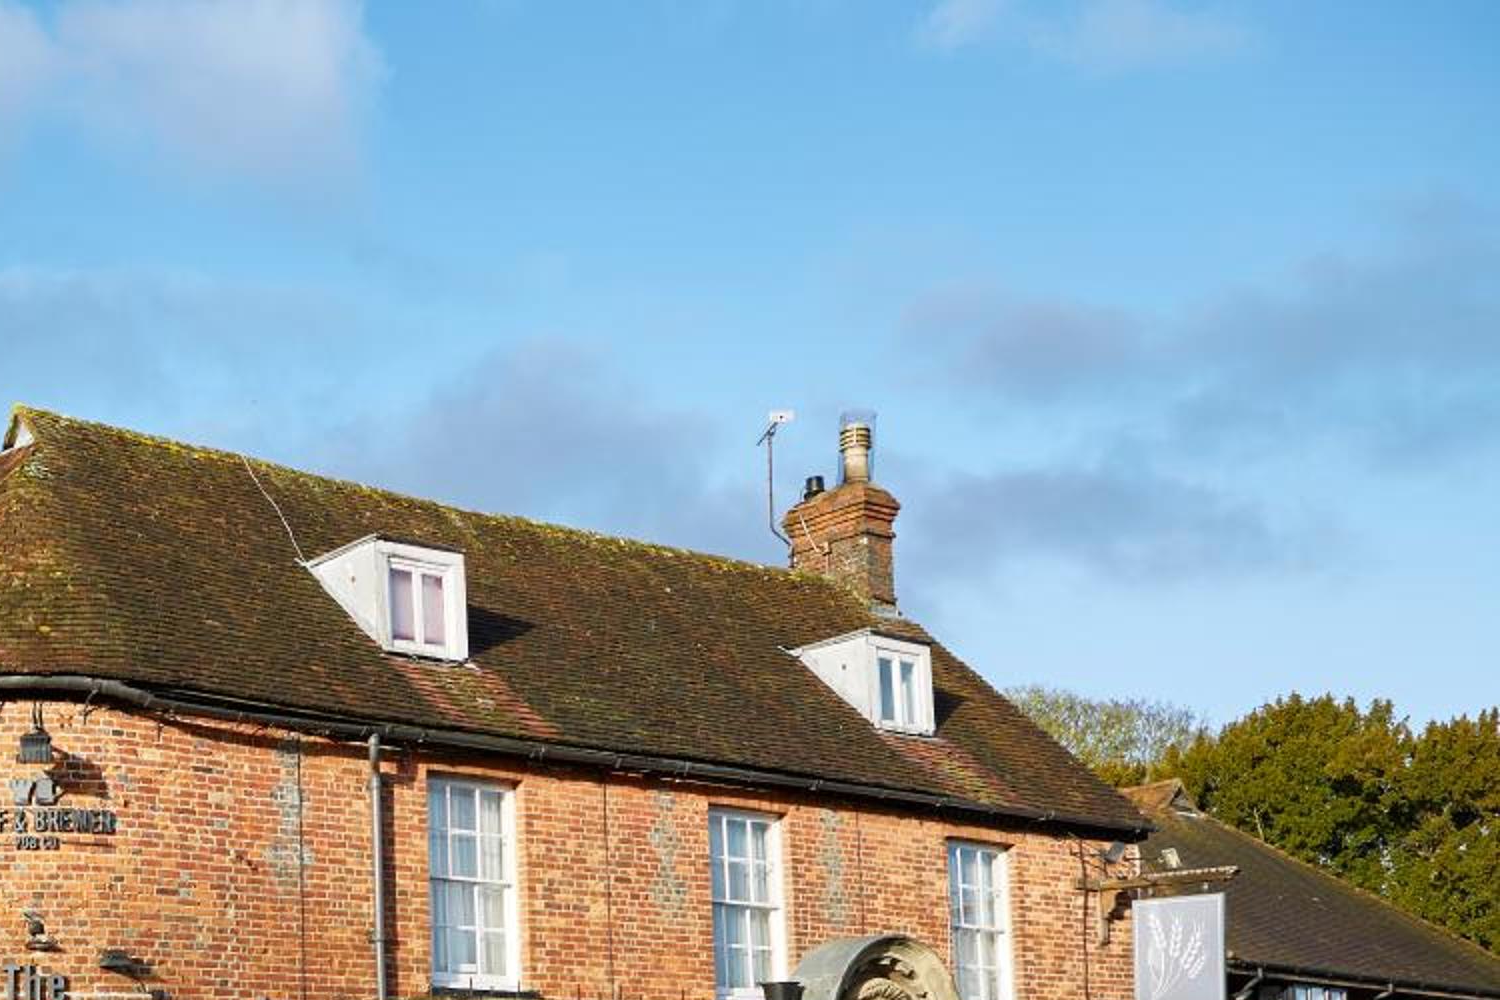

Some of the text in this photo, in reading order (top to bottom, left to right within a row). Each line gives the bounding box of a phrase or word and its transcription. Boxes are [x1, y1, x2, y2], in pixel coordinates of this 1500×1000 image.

[14, 808, 28, 833] &
[35, 809, 117, 835] BREWER
[16, 836, 39, 850] PUB
